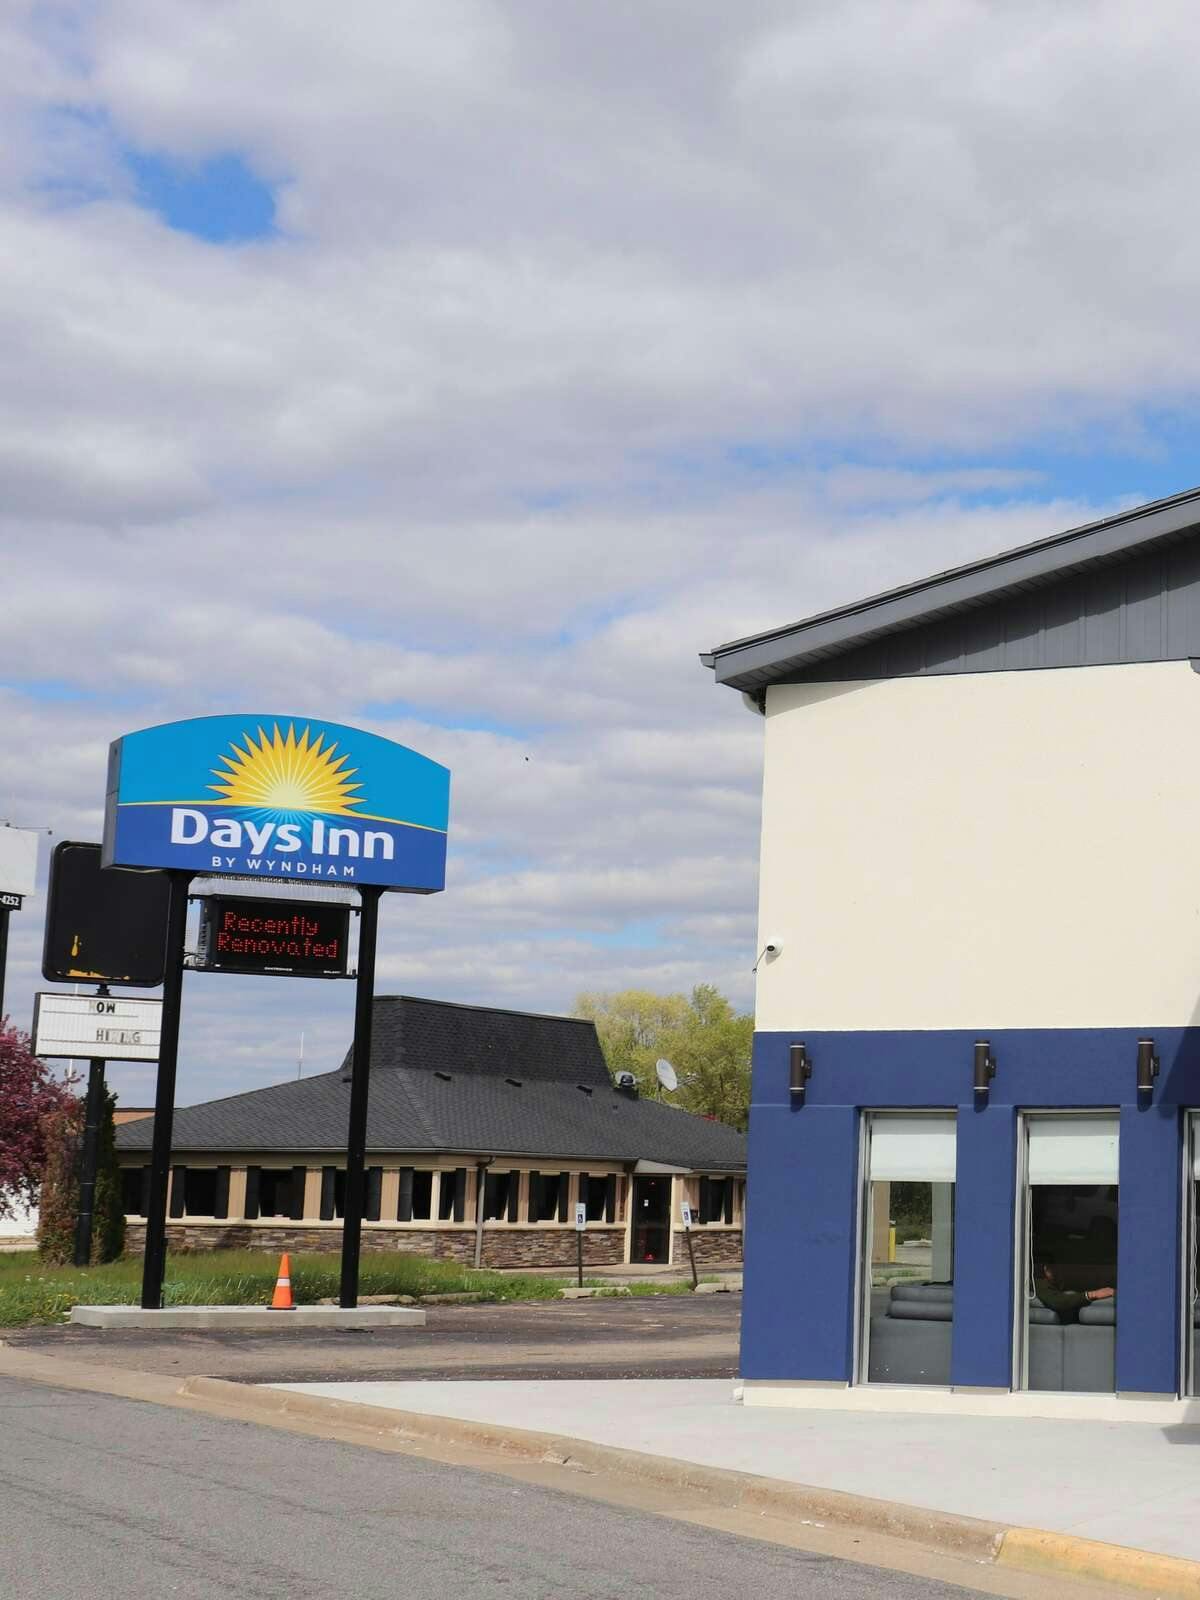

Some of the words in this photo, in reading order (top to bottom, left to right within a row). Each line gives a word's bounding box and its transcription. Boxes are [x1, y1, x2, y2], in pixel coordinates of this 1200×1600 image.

[171, 808, 302, 855] Days
[311, 819, 395, 860] Inn
[212, 856, 236, 868] BY
[247, 858, 355, 877] WYNDHAM
[224, 911, 319, 936] Recently
[217, 932, 338, 958] Renovated
[89, 1000, 115, 1013] OW
